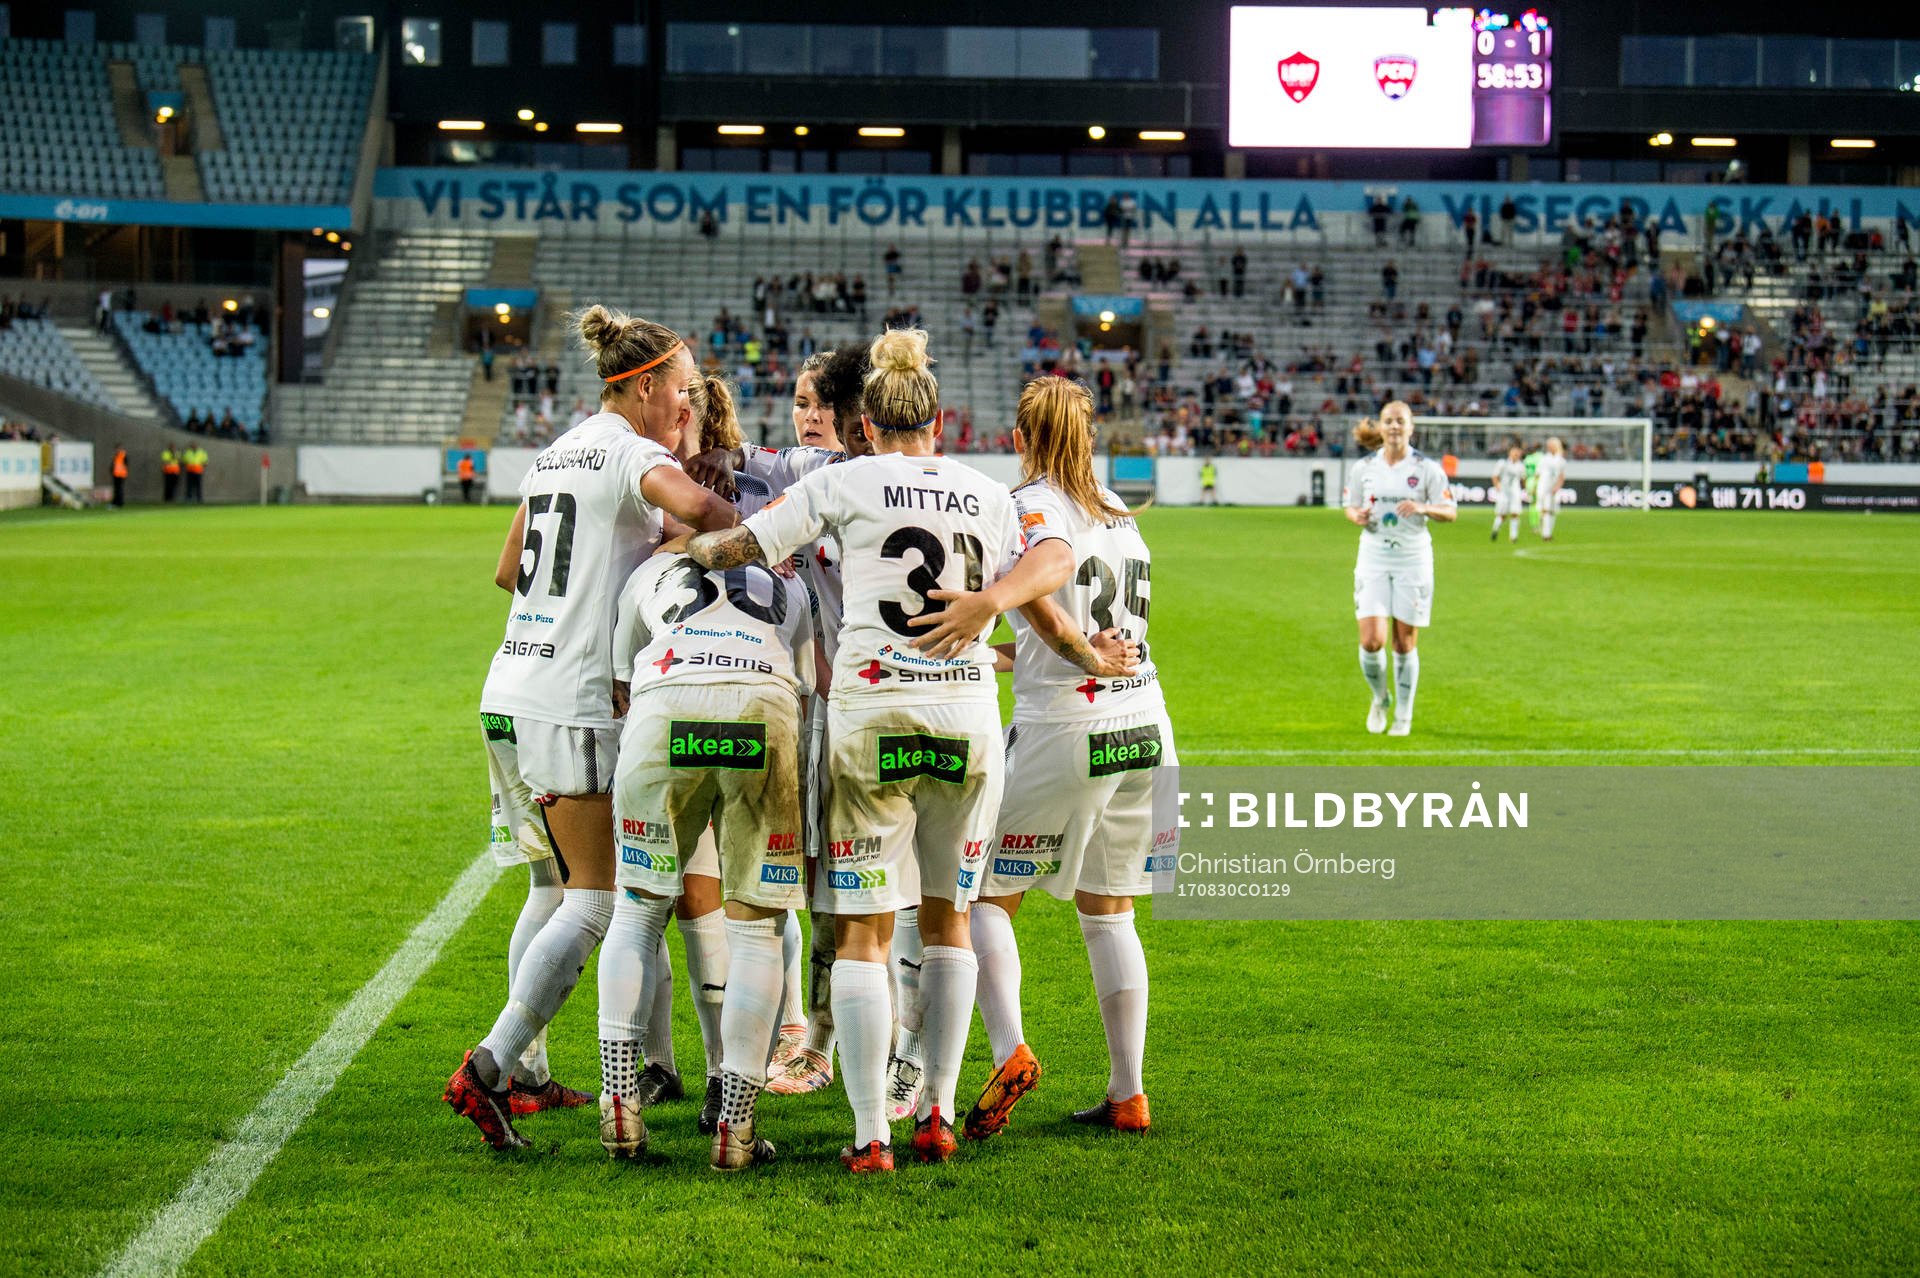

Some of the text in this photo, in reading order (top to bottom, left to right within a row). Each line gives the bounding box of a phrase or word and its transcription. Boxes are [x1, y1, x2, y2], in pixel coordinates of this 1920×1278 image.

[1477, 30, 1495, 55] 0
[1528, 31, 1541, 55] 1
[1477, 63, 1543, 89] 58:53
[412, 179, 461, 218] VI
[478, 172, 600, 221] STÅR
[616, 183, 729, 224] SOM
[746, 186, 811, 225] EN
[827, 177, 928, 227] FÖR
[1193, 191, 1321, 232] ALLA
[1440, 193, 1491, 236] VI
[883, 485, 980, 517] MITTAG
[1712, 487, 1737, 509] till
[1739, 487, 1763, 509] 71
[1766, 488, 1806, 510] 140
[878, 526, 983, 642] 31
[535, 613, 554, 624] Pizza
[684, 626, 763, 645] Domino's Pizza
[892, 652, 942, 667] Domino's
[671, 733, 734, 756] akea
[1092, 743, 1140, 766] akea
[881, 747, 937, 770] akea
[1001, 834, 1064, 849] RIXFM
[625, 848, 648, 866] MKB
[999, 861, 1031, 874] MKB
[1150, 856, 1175, 870] MKB
[767, 867, 797, 881] MKB
[830, 873, 856, 887] MKB
